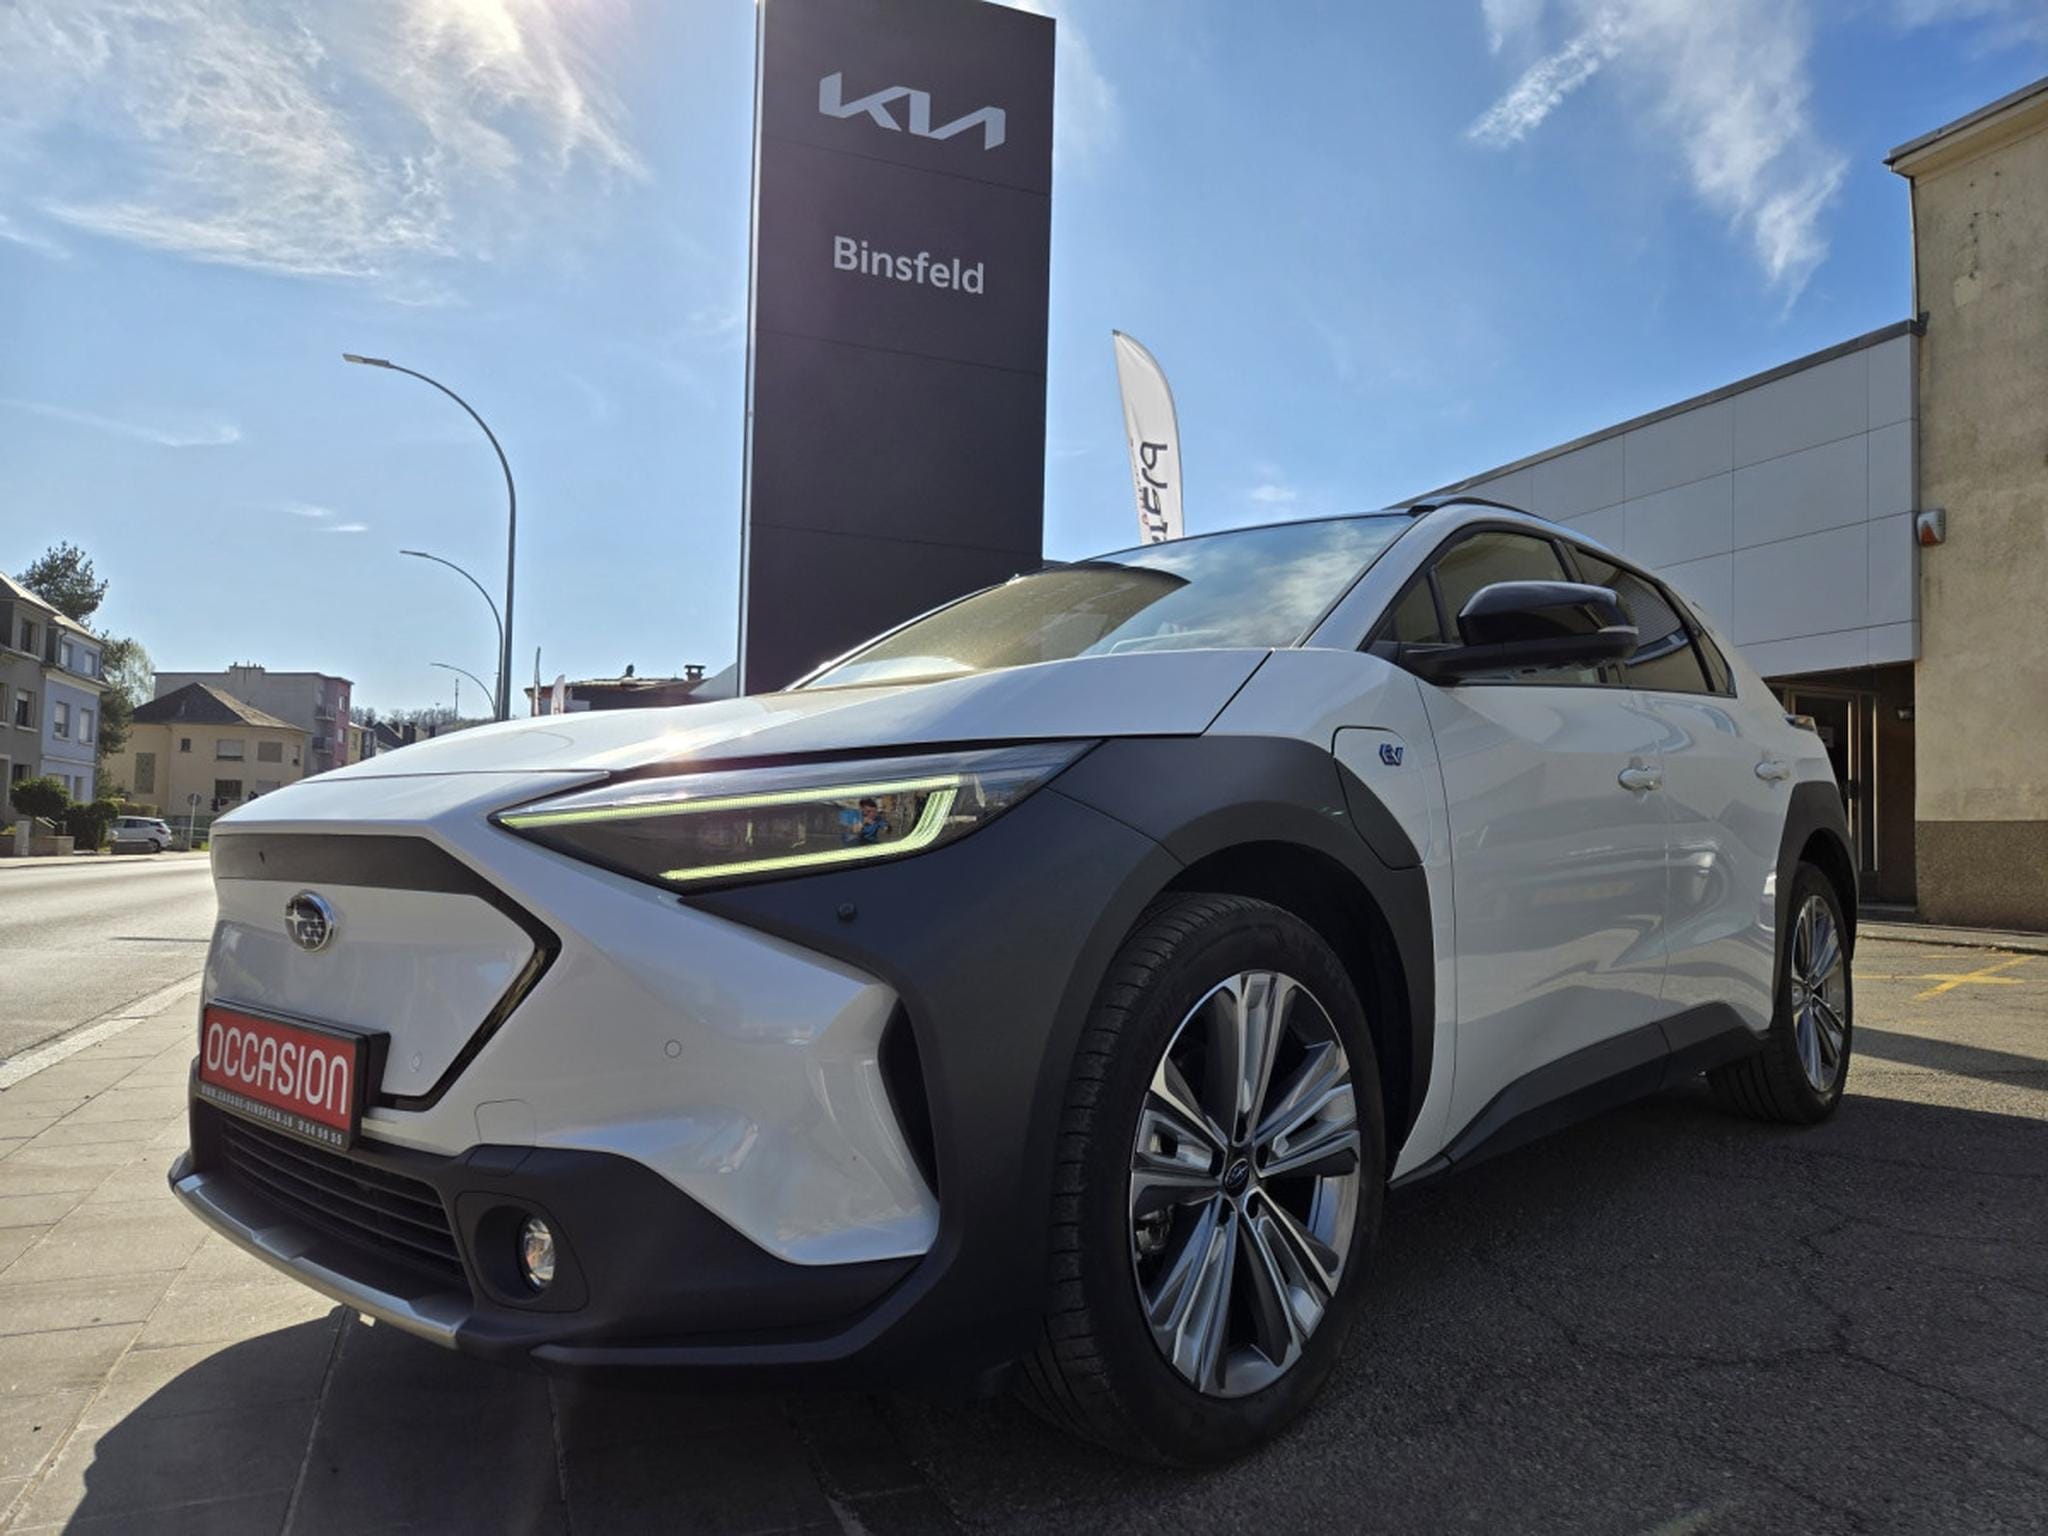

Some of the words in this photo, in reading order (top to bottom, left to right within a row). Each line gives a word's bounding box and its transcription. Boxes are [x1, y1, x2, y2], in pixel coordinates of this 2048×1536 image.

[818, 71, 1006, 151] KIA
[833, 235, 985, 294] Binsfeld
[206, 1023, 348, 1115] OCCASION
